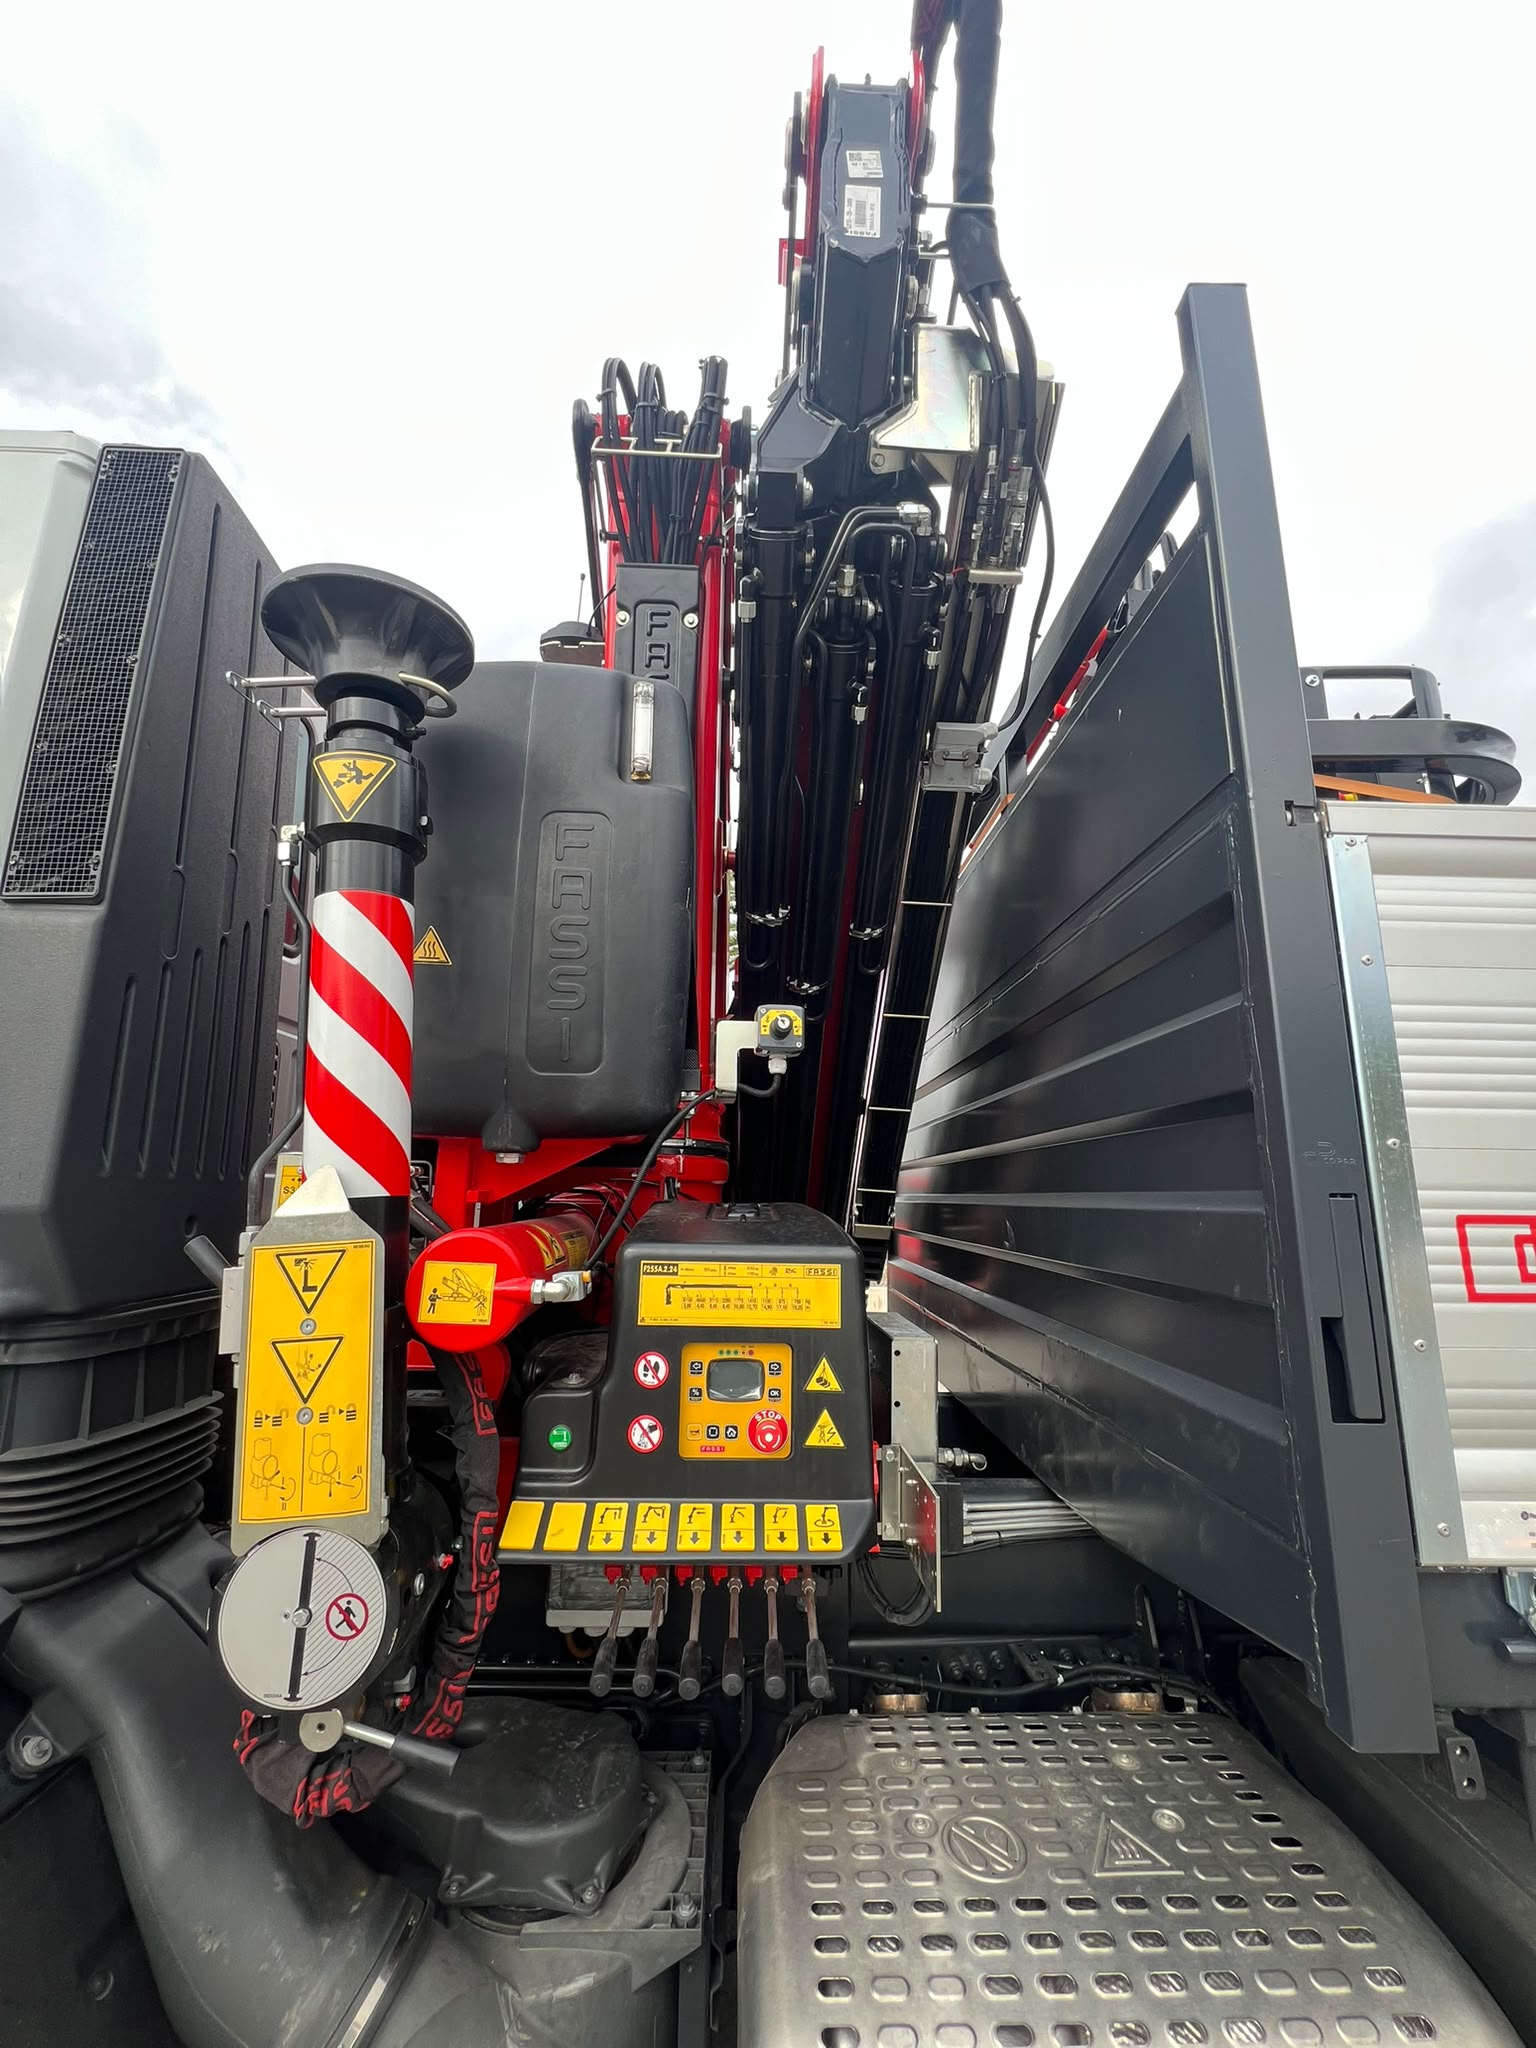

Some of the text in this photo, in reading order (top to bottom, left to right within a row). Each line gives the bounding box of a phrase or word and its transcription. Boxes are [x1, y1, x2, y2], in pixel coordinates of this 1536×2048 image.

[644, 610, 672, 679] FA
[545, 822, 595, 1063] FASSI
[643, 1264, 678, 1274] F255A.2.24
[754, 1410, 783, 1422] STOP
